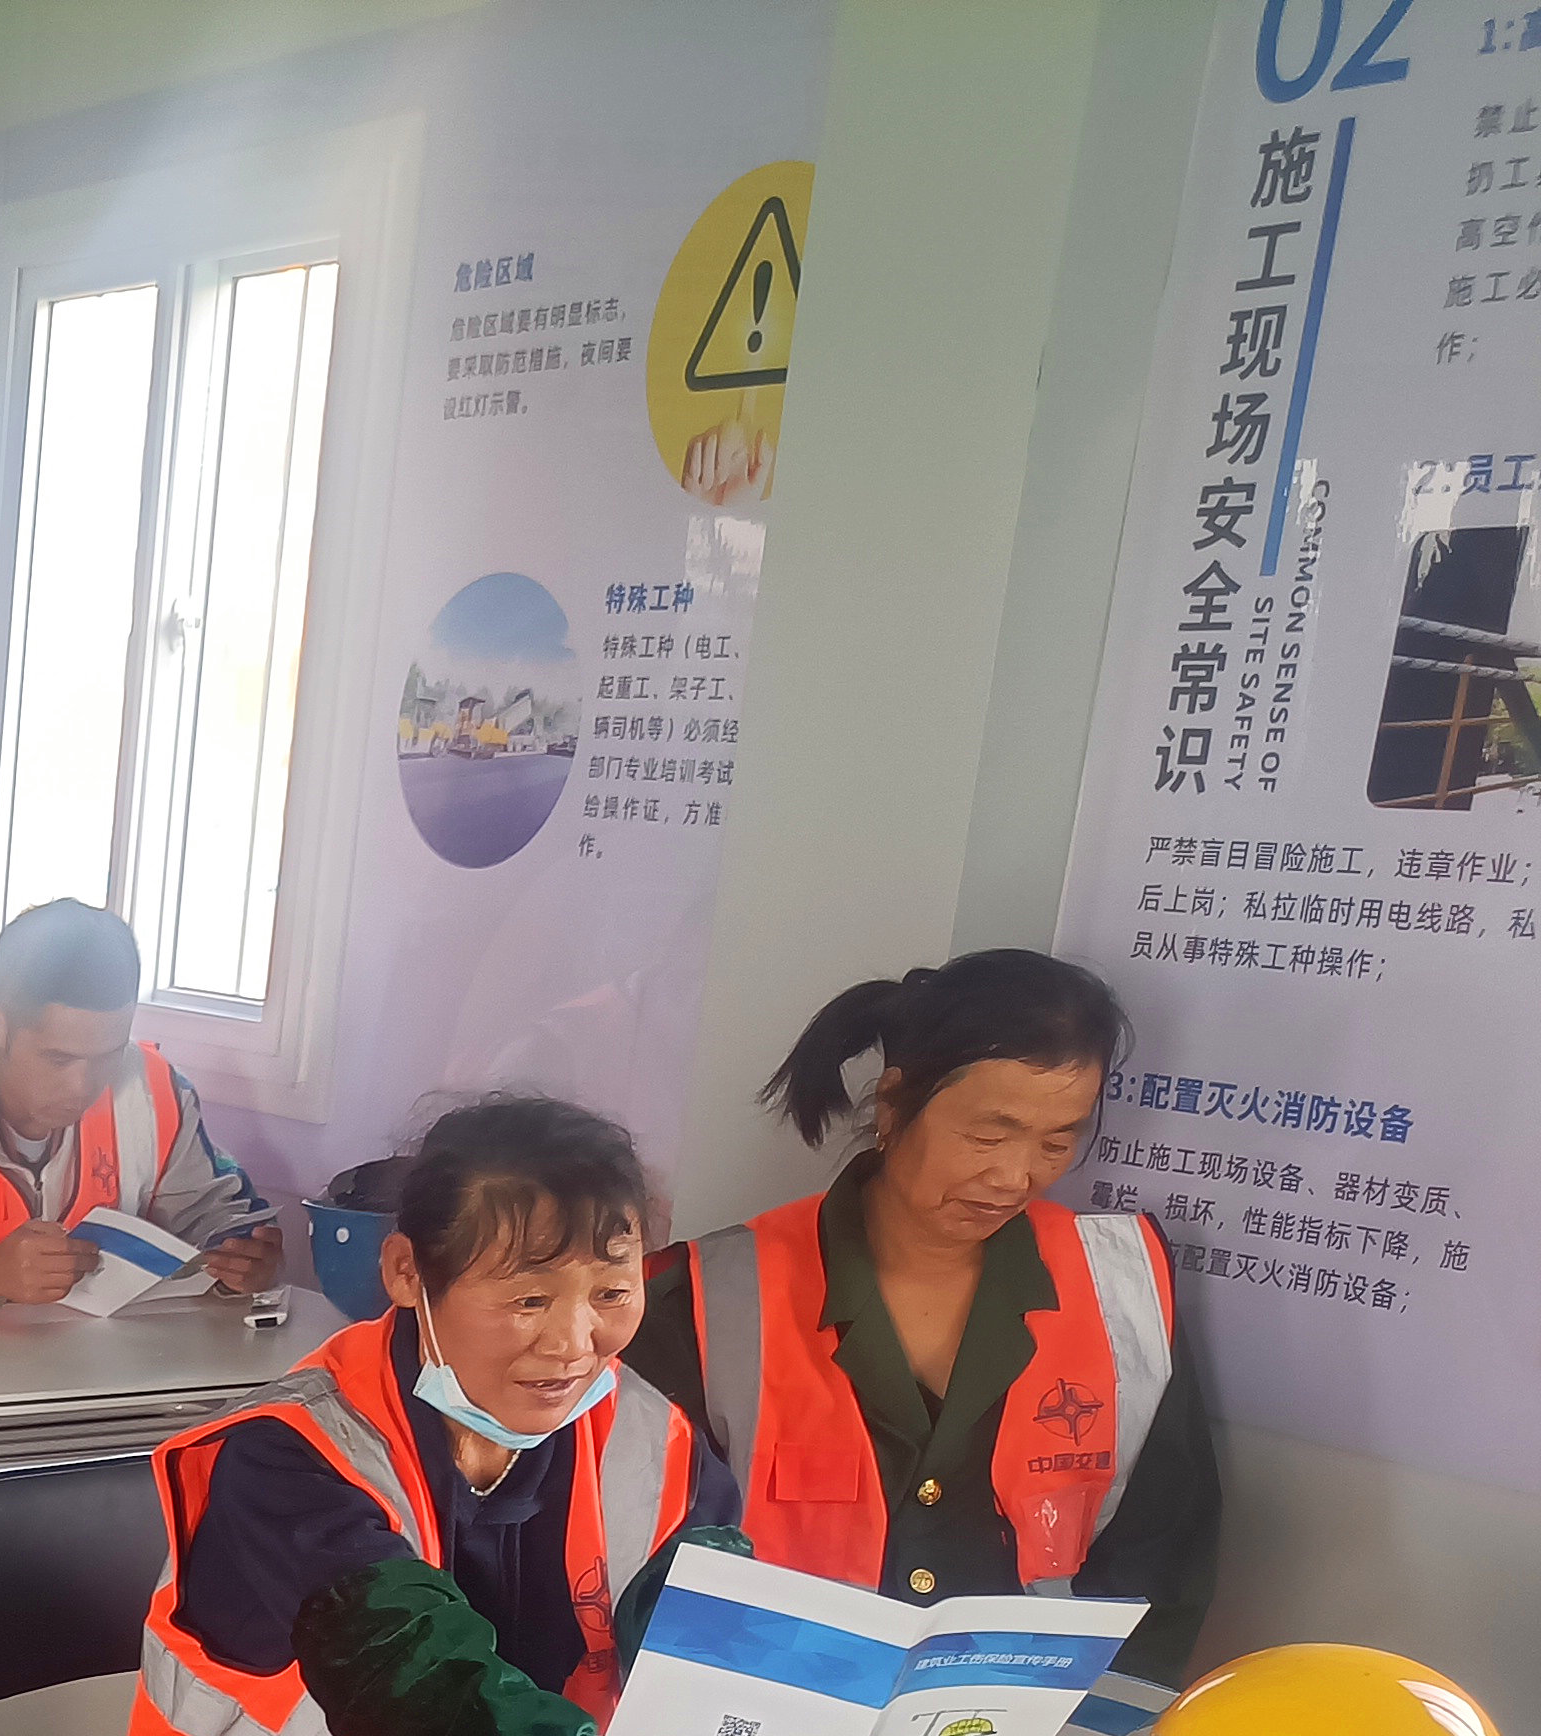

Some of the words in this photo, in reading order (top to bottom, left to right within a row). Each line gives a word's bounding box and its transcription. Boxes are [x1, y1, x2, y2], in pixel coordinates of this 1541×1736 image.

[454, 252, 535, 293] 危险区域
[1155, 124, 1322, 796] 施工现场安全常识
[606, 582, 695, 615] 特殊工种
[602, 634, 740, 661] 特殊工种（电工、
[1244, 597, 1274, 665] SITE
[597, 675, 734, 703] 起重工、架子工、
[1265, 642, 1302, 744] SENSE
[593, 715, 740, 745] 辆司机等）必须经
[1224, 673, 1260, 791] SAFETY
[588, 756, 735, 787] 部门专业培训考试
[1258, 752, 1281, 793] OF
[1146, 835, 1532, 887] 严禁盲目冒险施工，违章作业；
[1137, 883, 1537, 941] 后上岗；私拉临时用电线路，私
[1130, 931, 1388, 982] 员从事特殊工种操作；
[1097, 1135, 1464, 1219] 防止施工现场设备、器材变质、
